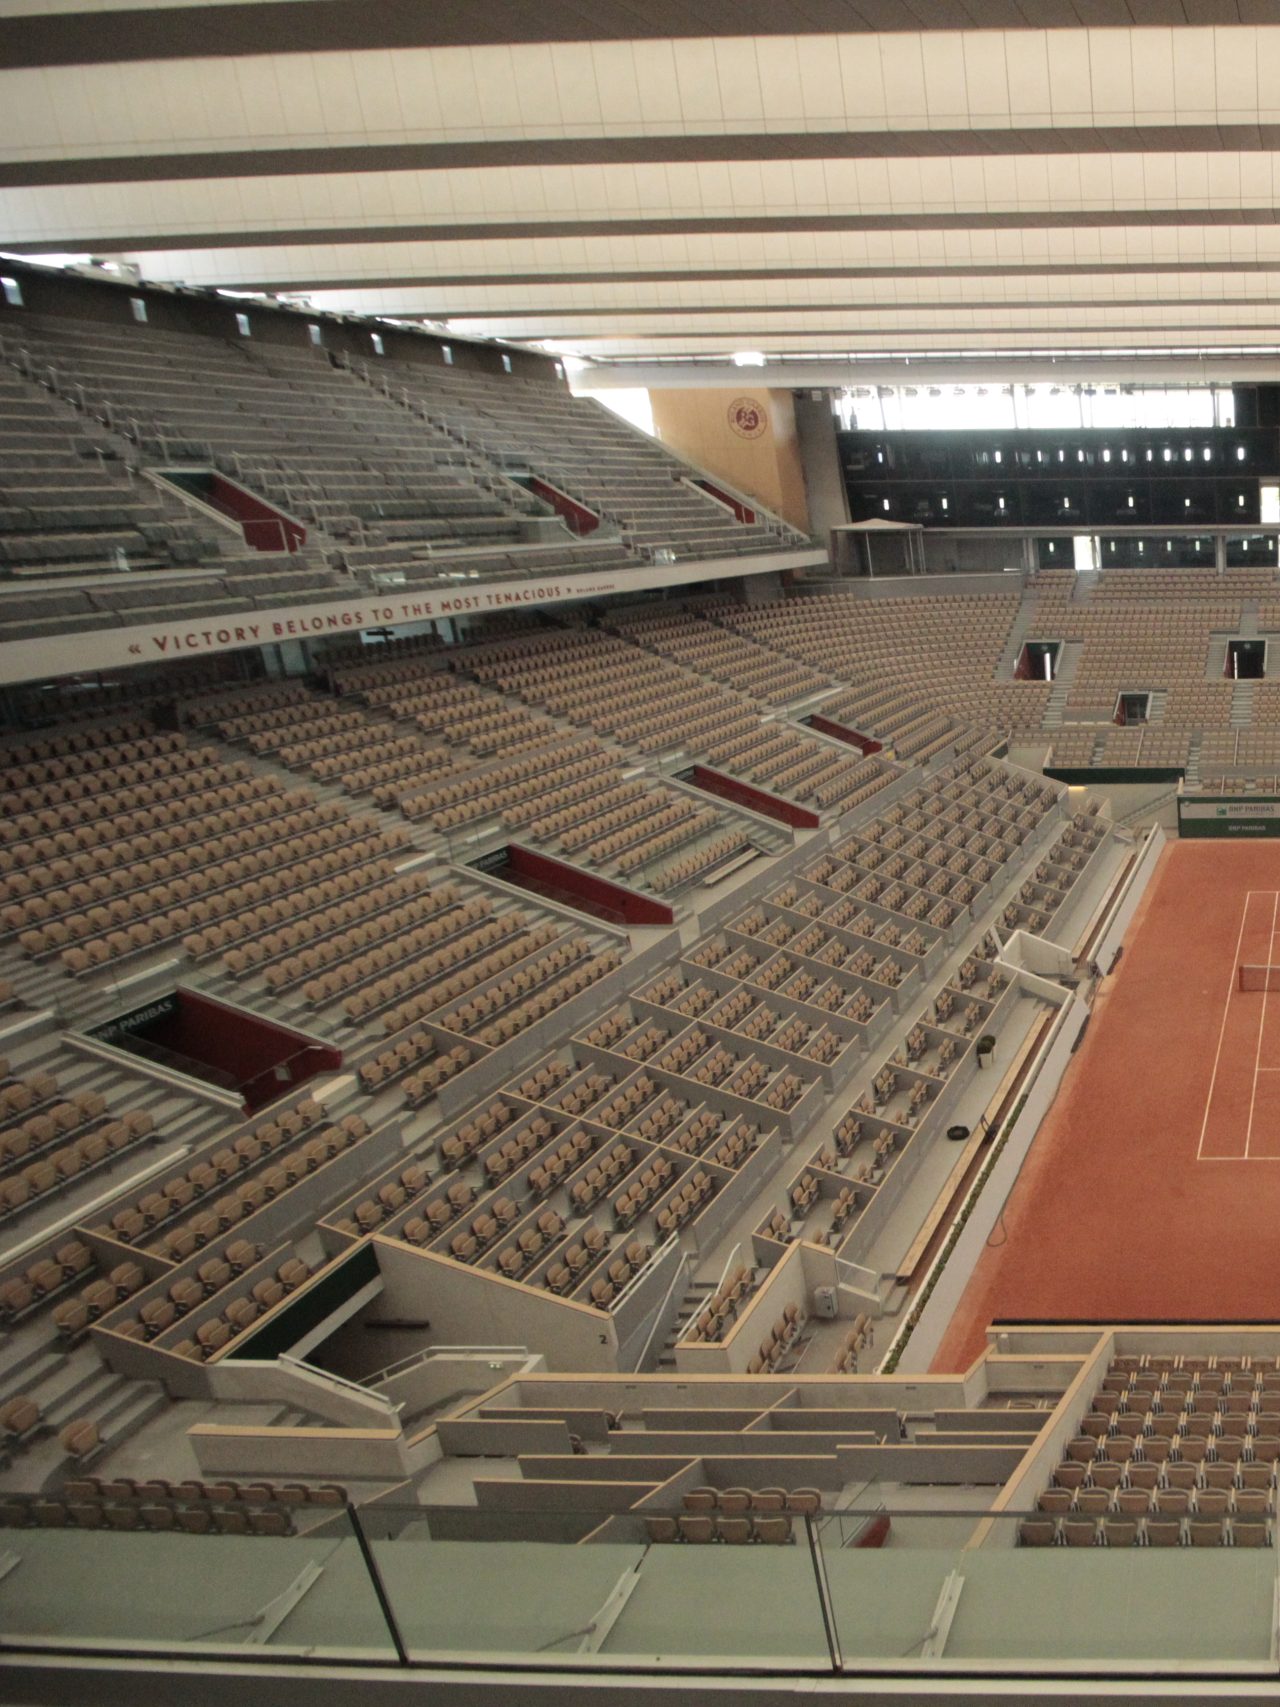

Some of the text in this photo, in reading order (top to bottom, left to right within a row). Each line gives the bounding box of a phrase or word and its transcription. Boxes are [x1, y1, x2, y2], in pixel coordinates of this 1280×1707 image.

[152, 625, 260, 651] VICTORY
[272, 611, 363, 636] BELONGS
[372, 607, 394, 621] TO
[401, 602, 433, 617] THE
[441, 595, 482, 612] MOST
[486, 586, 562, 605] TENACIOUS
[120, 1001, 173, 1031] PARIBAS
[599, 1335, 607, 1344] 2
